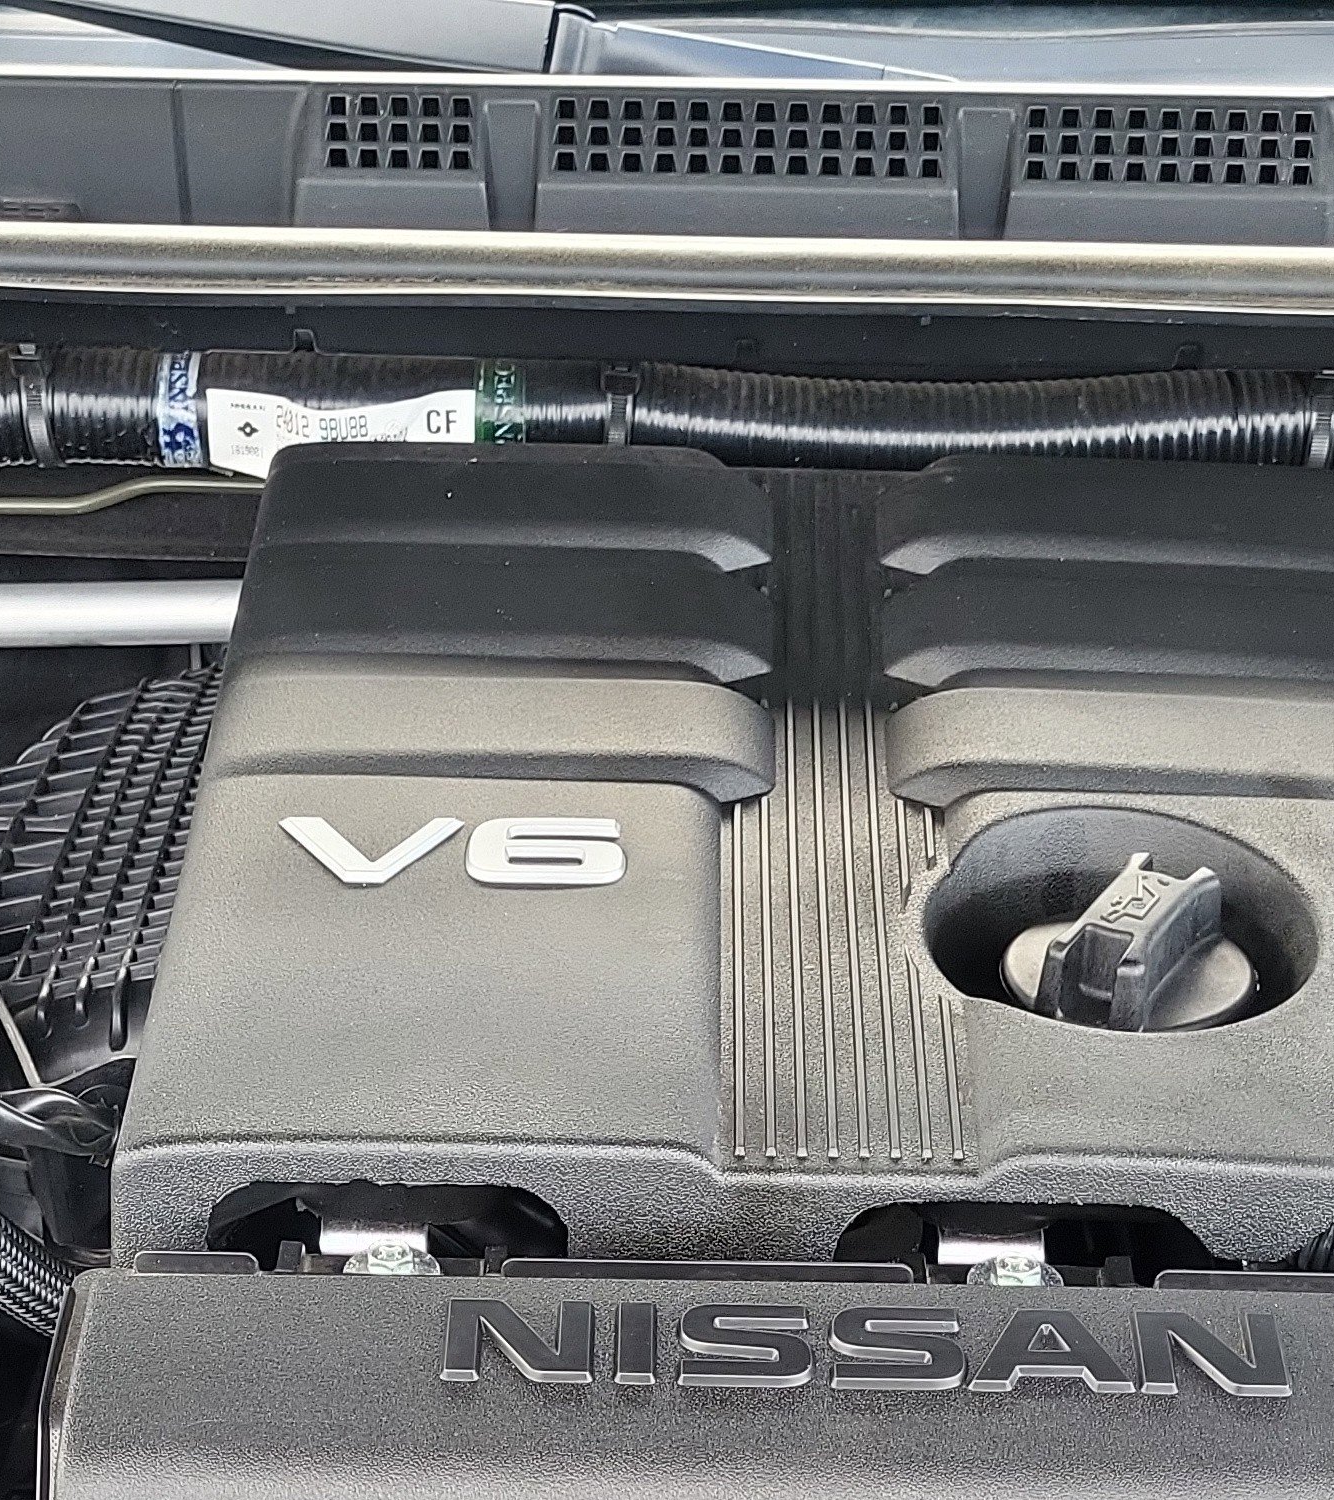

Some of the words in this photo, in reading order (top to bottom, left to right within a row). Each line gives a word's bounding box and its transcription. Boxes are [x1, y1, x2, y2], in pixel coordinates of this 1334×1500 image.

[425, 409, 458, 435] CF
[278, 816, 627, 885] V6
[438, 1298, 1293, 1398] NISSAN
